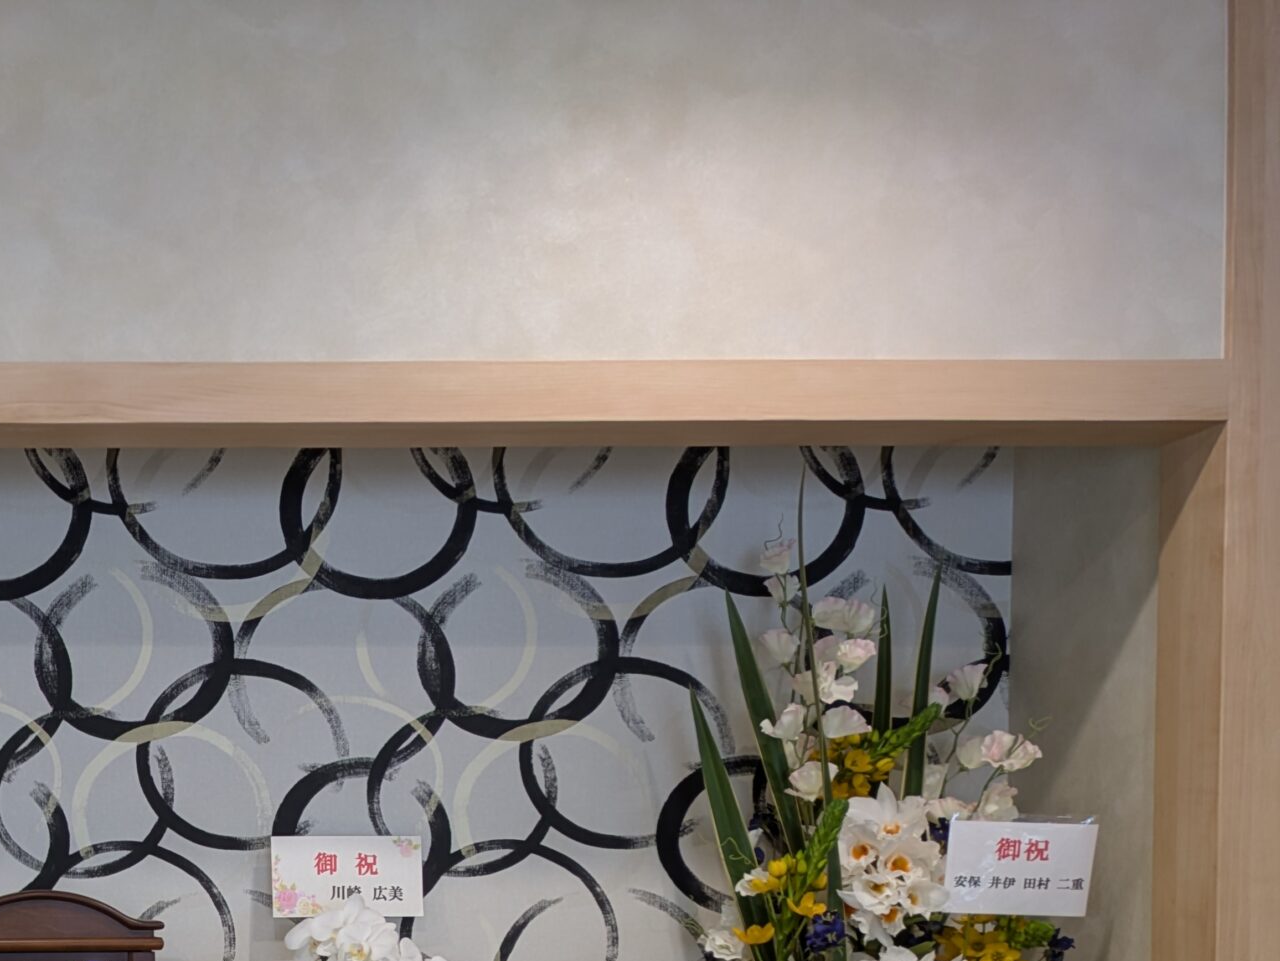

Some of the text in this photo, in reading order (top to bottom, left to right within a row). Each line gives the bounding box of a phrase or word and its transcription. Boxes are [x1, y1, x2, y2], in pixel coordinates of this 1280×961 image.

[995, 837, 1050, 861] 御祝
[954, 876, 1085, 890] 安保 井伊 田村 二重
[372, 885, 404, 901] 広美
